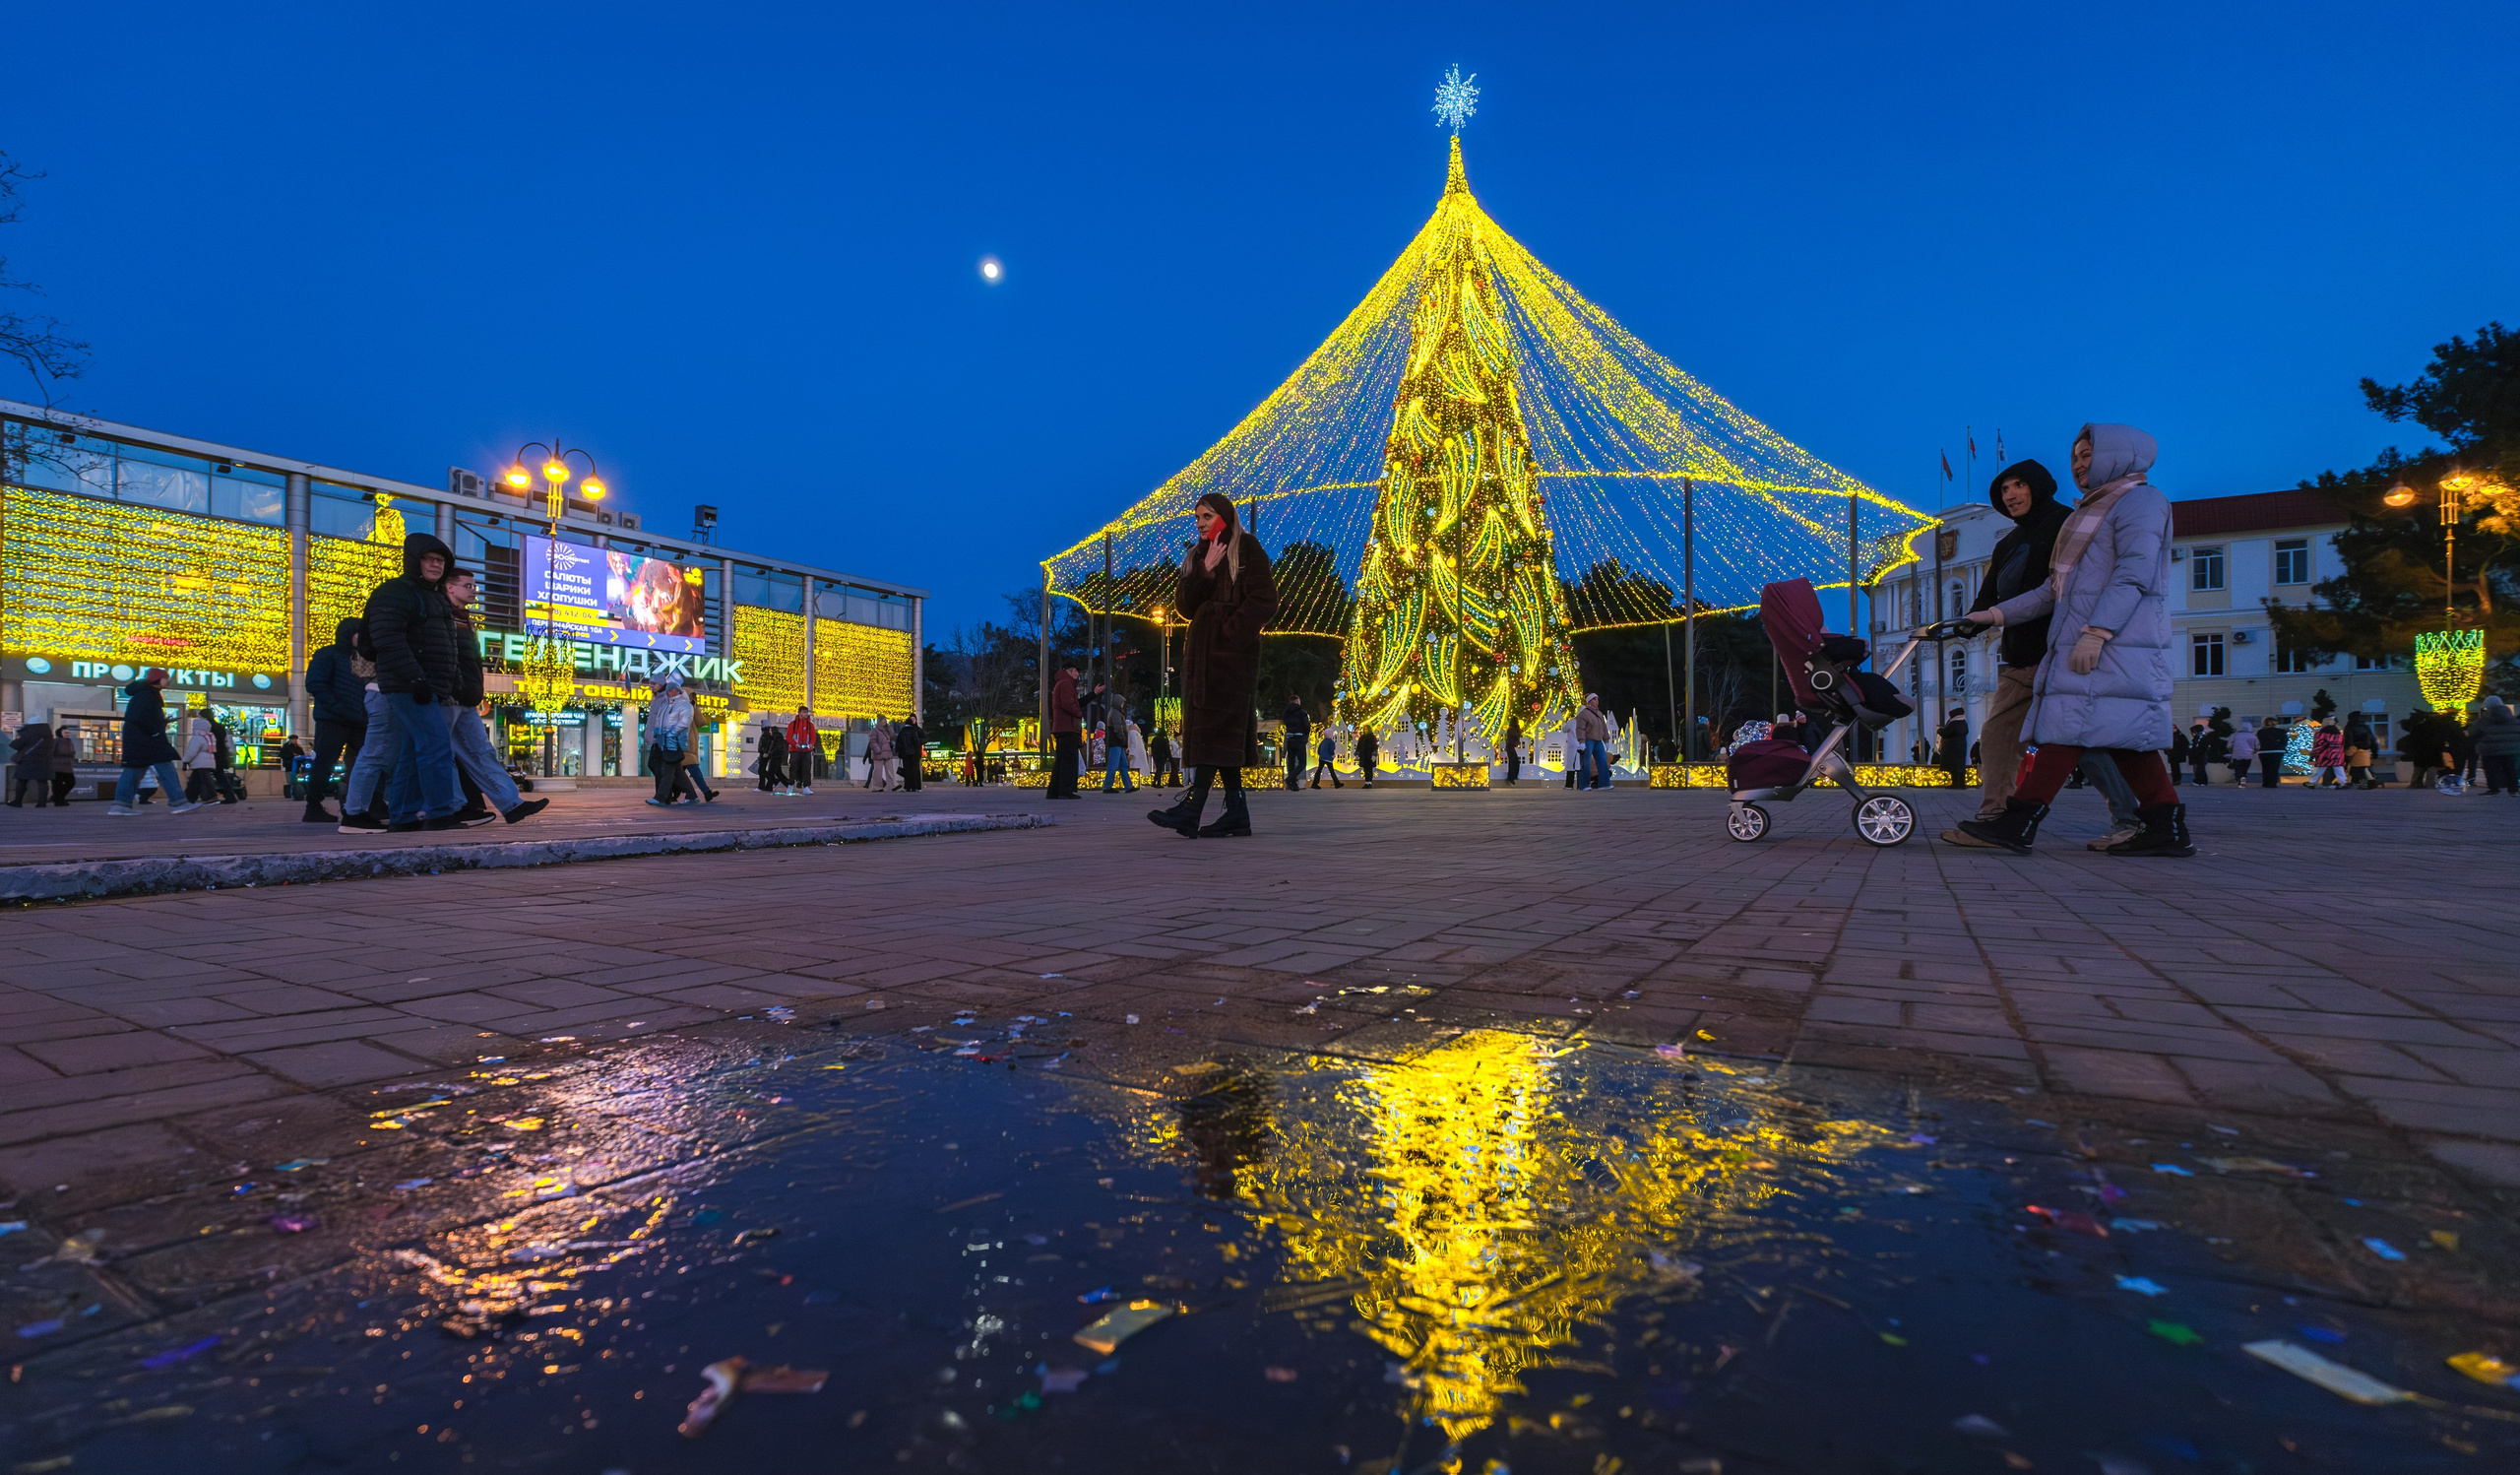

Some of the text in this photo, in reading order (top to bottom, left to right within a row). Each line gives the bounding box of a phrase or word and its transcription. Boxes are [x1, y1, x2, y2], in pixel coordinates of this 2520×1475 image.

[543, 570, 592, 585] САЛЮТЫ
[544, 581, 592, 596] ШАРИКИ
[536, 591, 598, 607] ХЛОПУШКИ
[532, 618, 589, 632] ПЕРМАЙСКАЯ
[697, 695, 729, 708] НТР
[816, 717, 845, 728] ТРАВЫ
